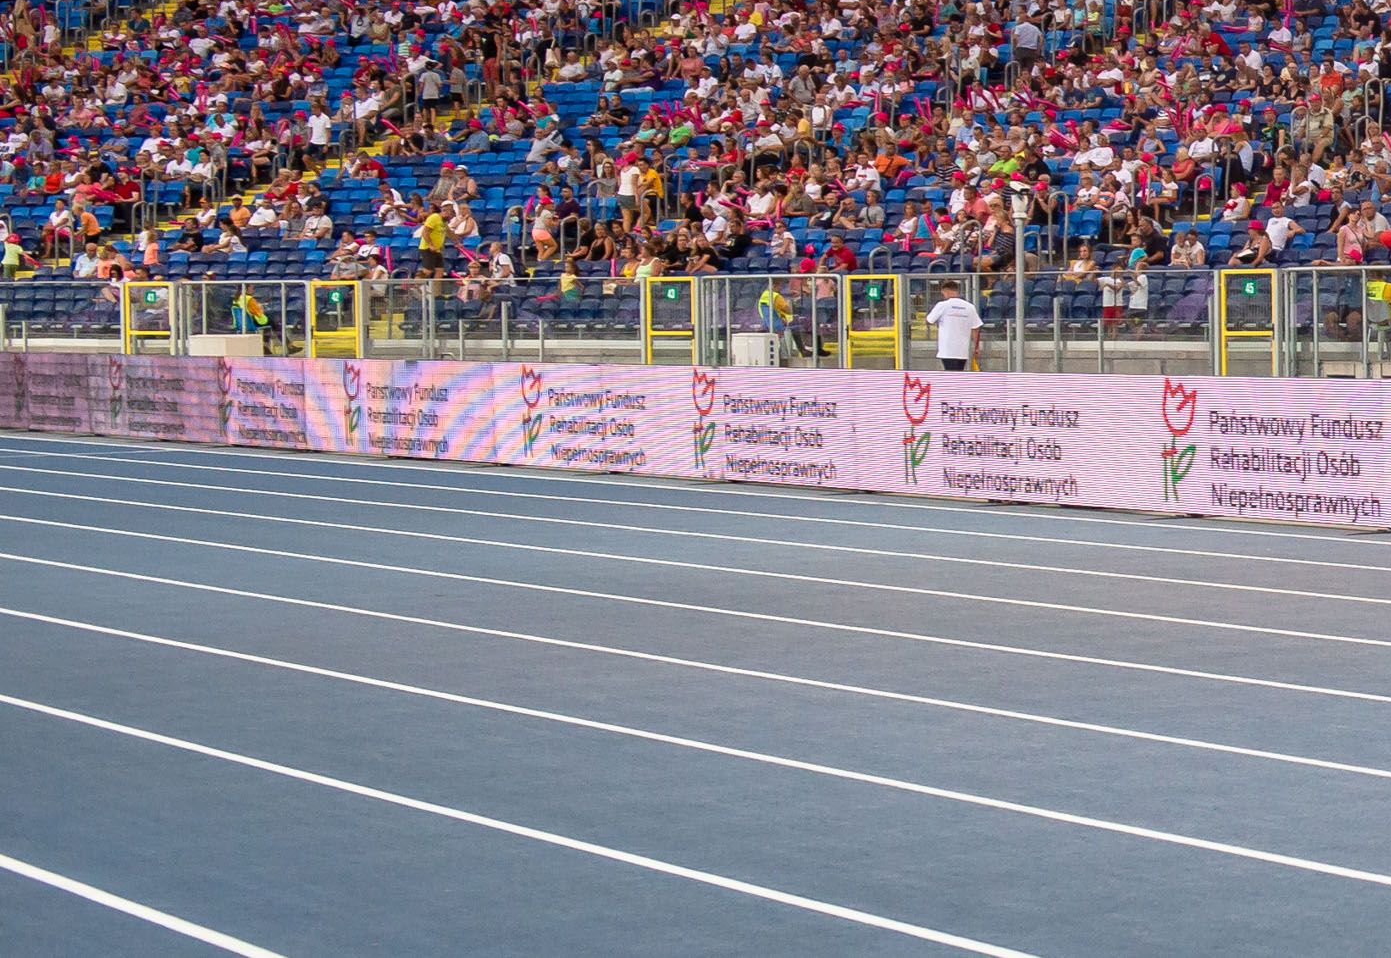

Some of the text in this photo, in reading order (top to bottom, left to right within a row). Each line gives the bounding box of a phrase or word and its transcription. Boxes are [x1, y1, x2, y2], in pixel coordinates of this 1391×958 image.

[1245, 282, 1254, 294] 45
[789, 397, 838, 418] Fundusz
[941, 400, 1080, 430] Państwowy Fundusz
[1209, 409, 1384, 444] Państwowy Fundusz
[1026, 437, 1063, 460] Osób
[1210, 447, 1361, 483] Rehabilitacji Osób
[1211, 482, 1381, 523] Niepełnosprawnych
